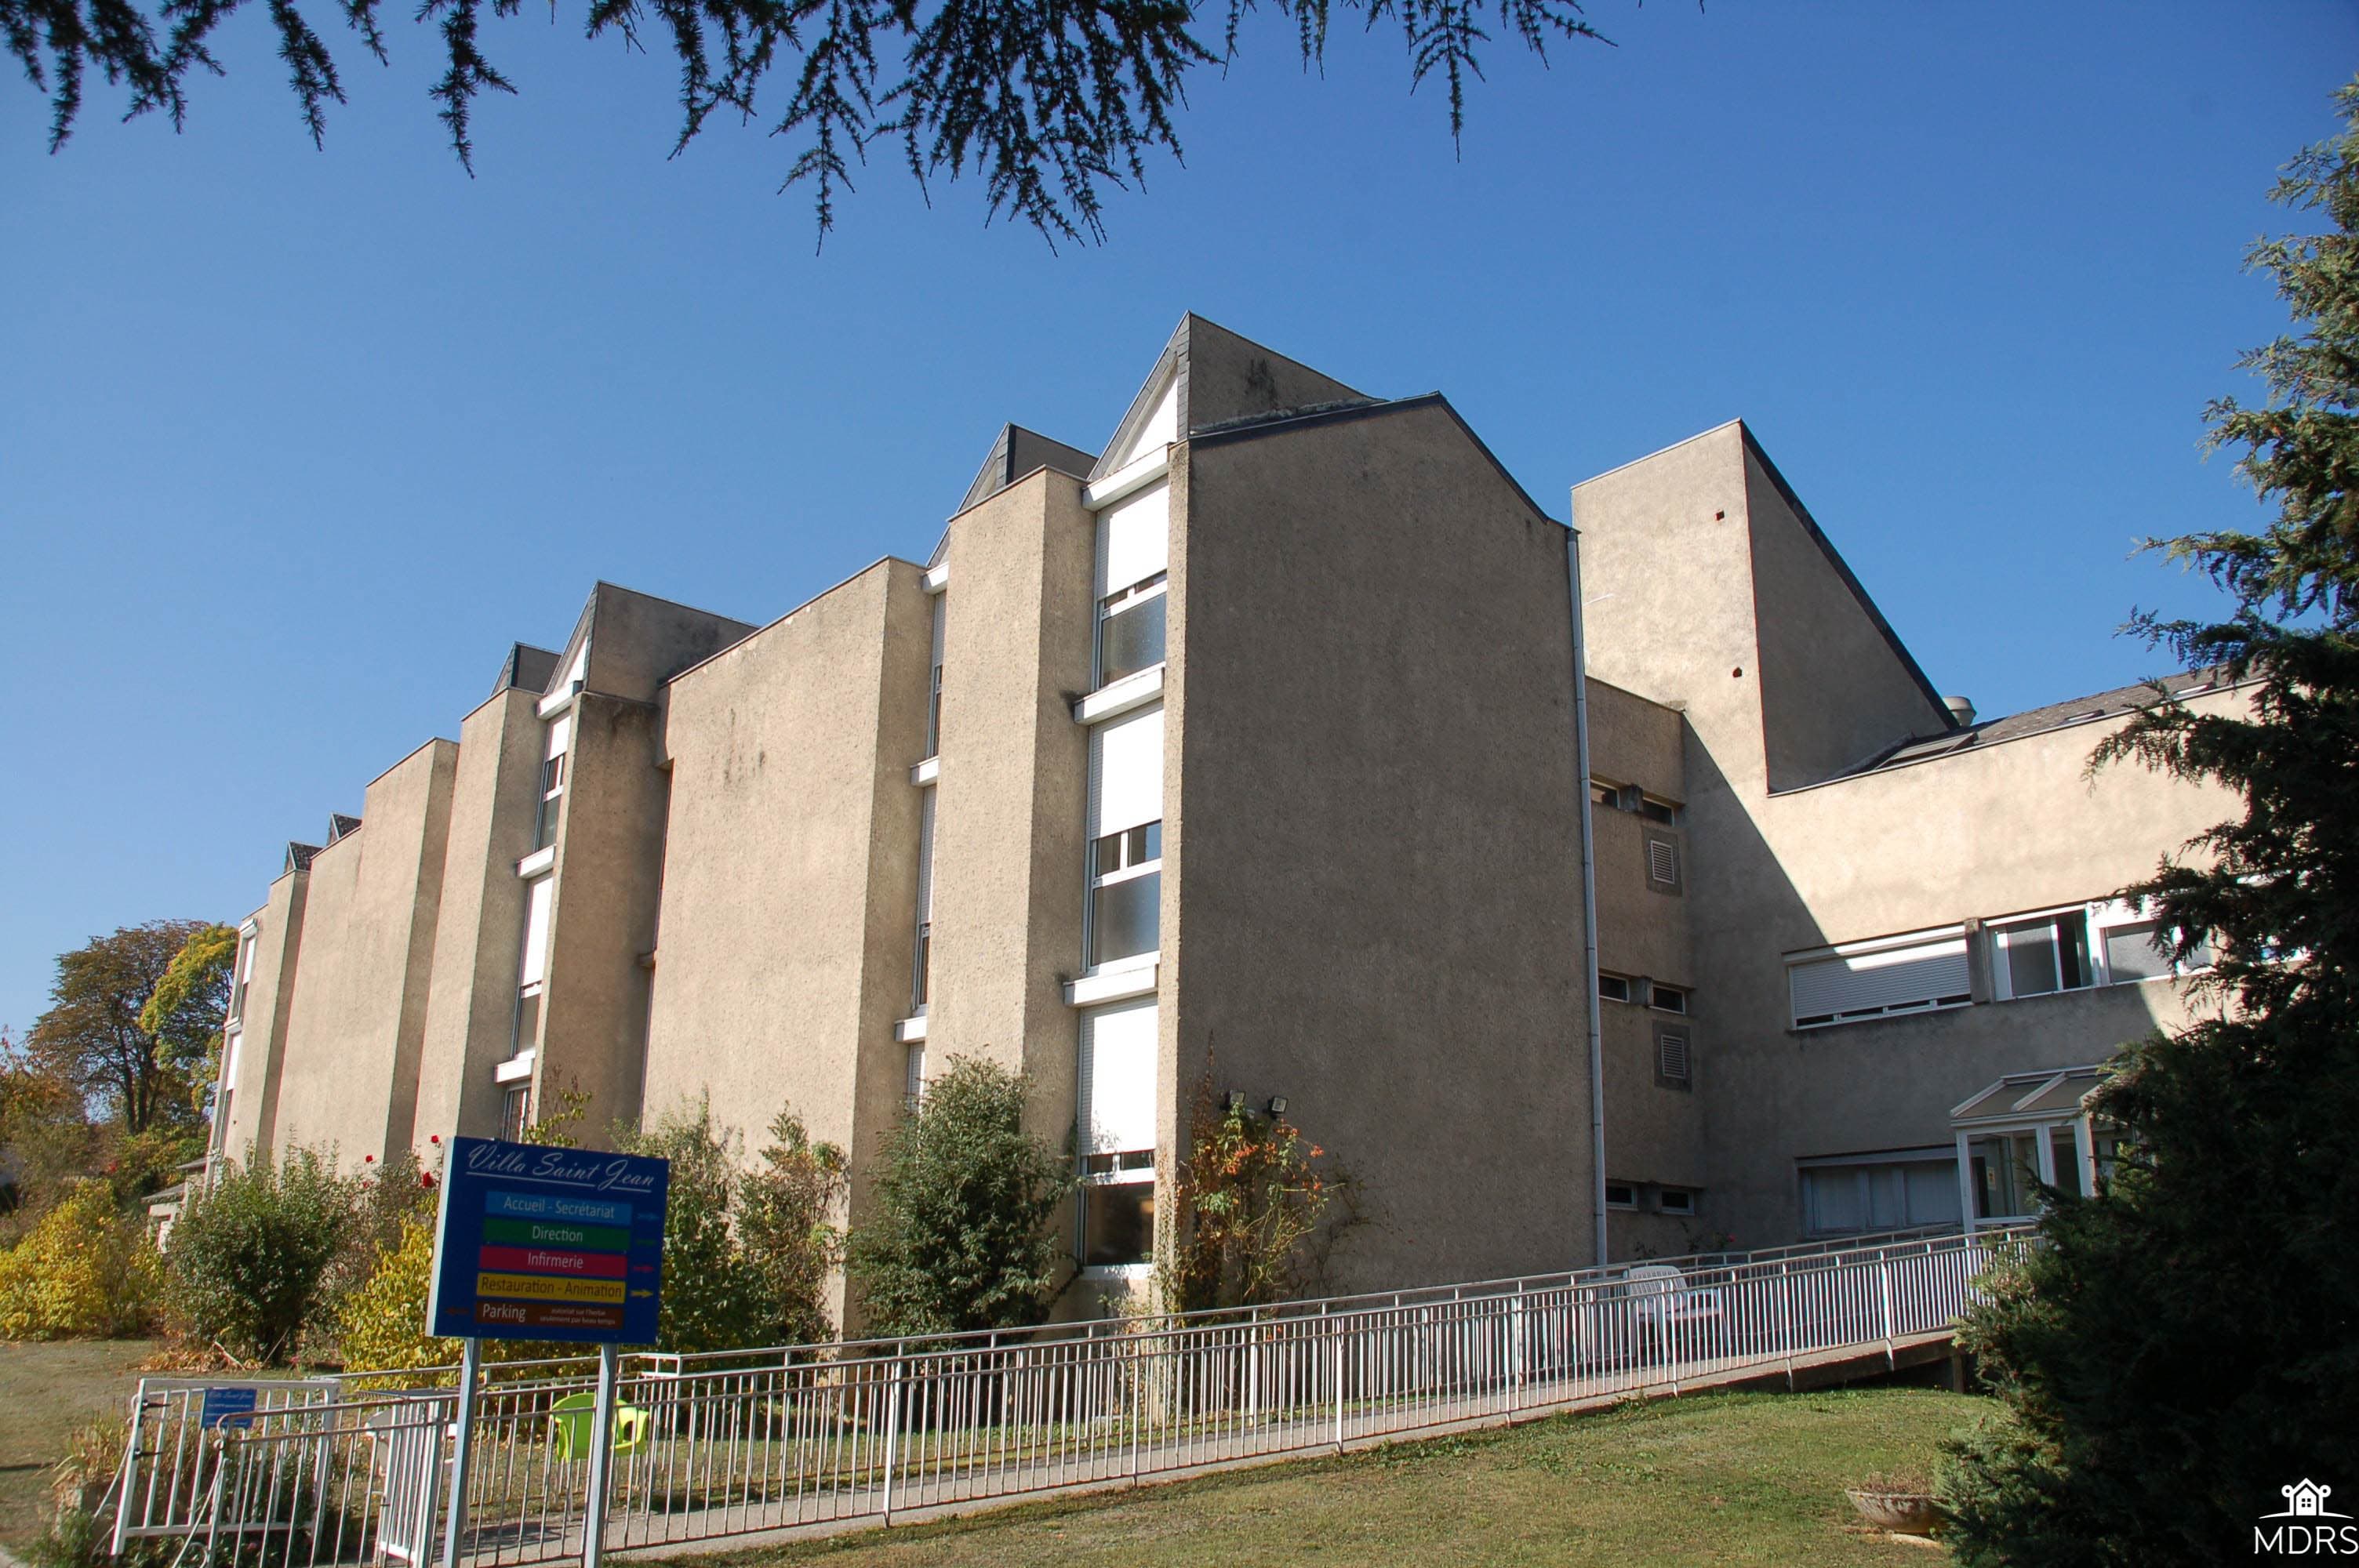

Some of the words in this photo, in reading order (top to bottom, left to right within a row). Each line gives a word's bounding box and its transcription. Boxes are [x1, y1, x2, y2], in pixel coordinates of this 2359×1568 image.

[468, 1144, 526, 1173] Villa
[533, 1152, 600, 1180] Saint
[597, 1159, 654, 1191] Jean
[503, 1196, 545, 1212] Accueil
[555, 1200, 615, 1218] Secrétariat
[532, 1225, 583, 1242] Direction
[528, 1252, 583, 1269] Infirmerie
[482, 1276, 554, 1294] Restauration
[565, 1281, 622, 1298] Animation
[482, 1303, 526, 1323] Parking
